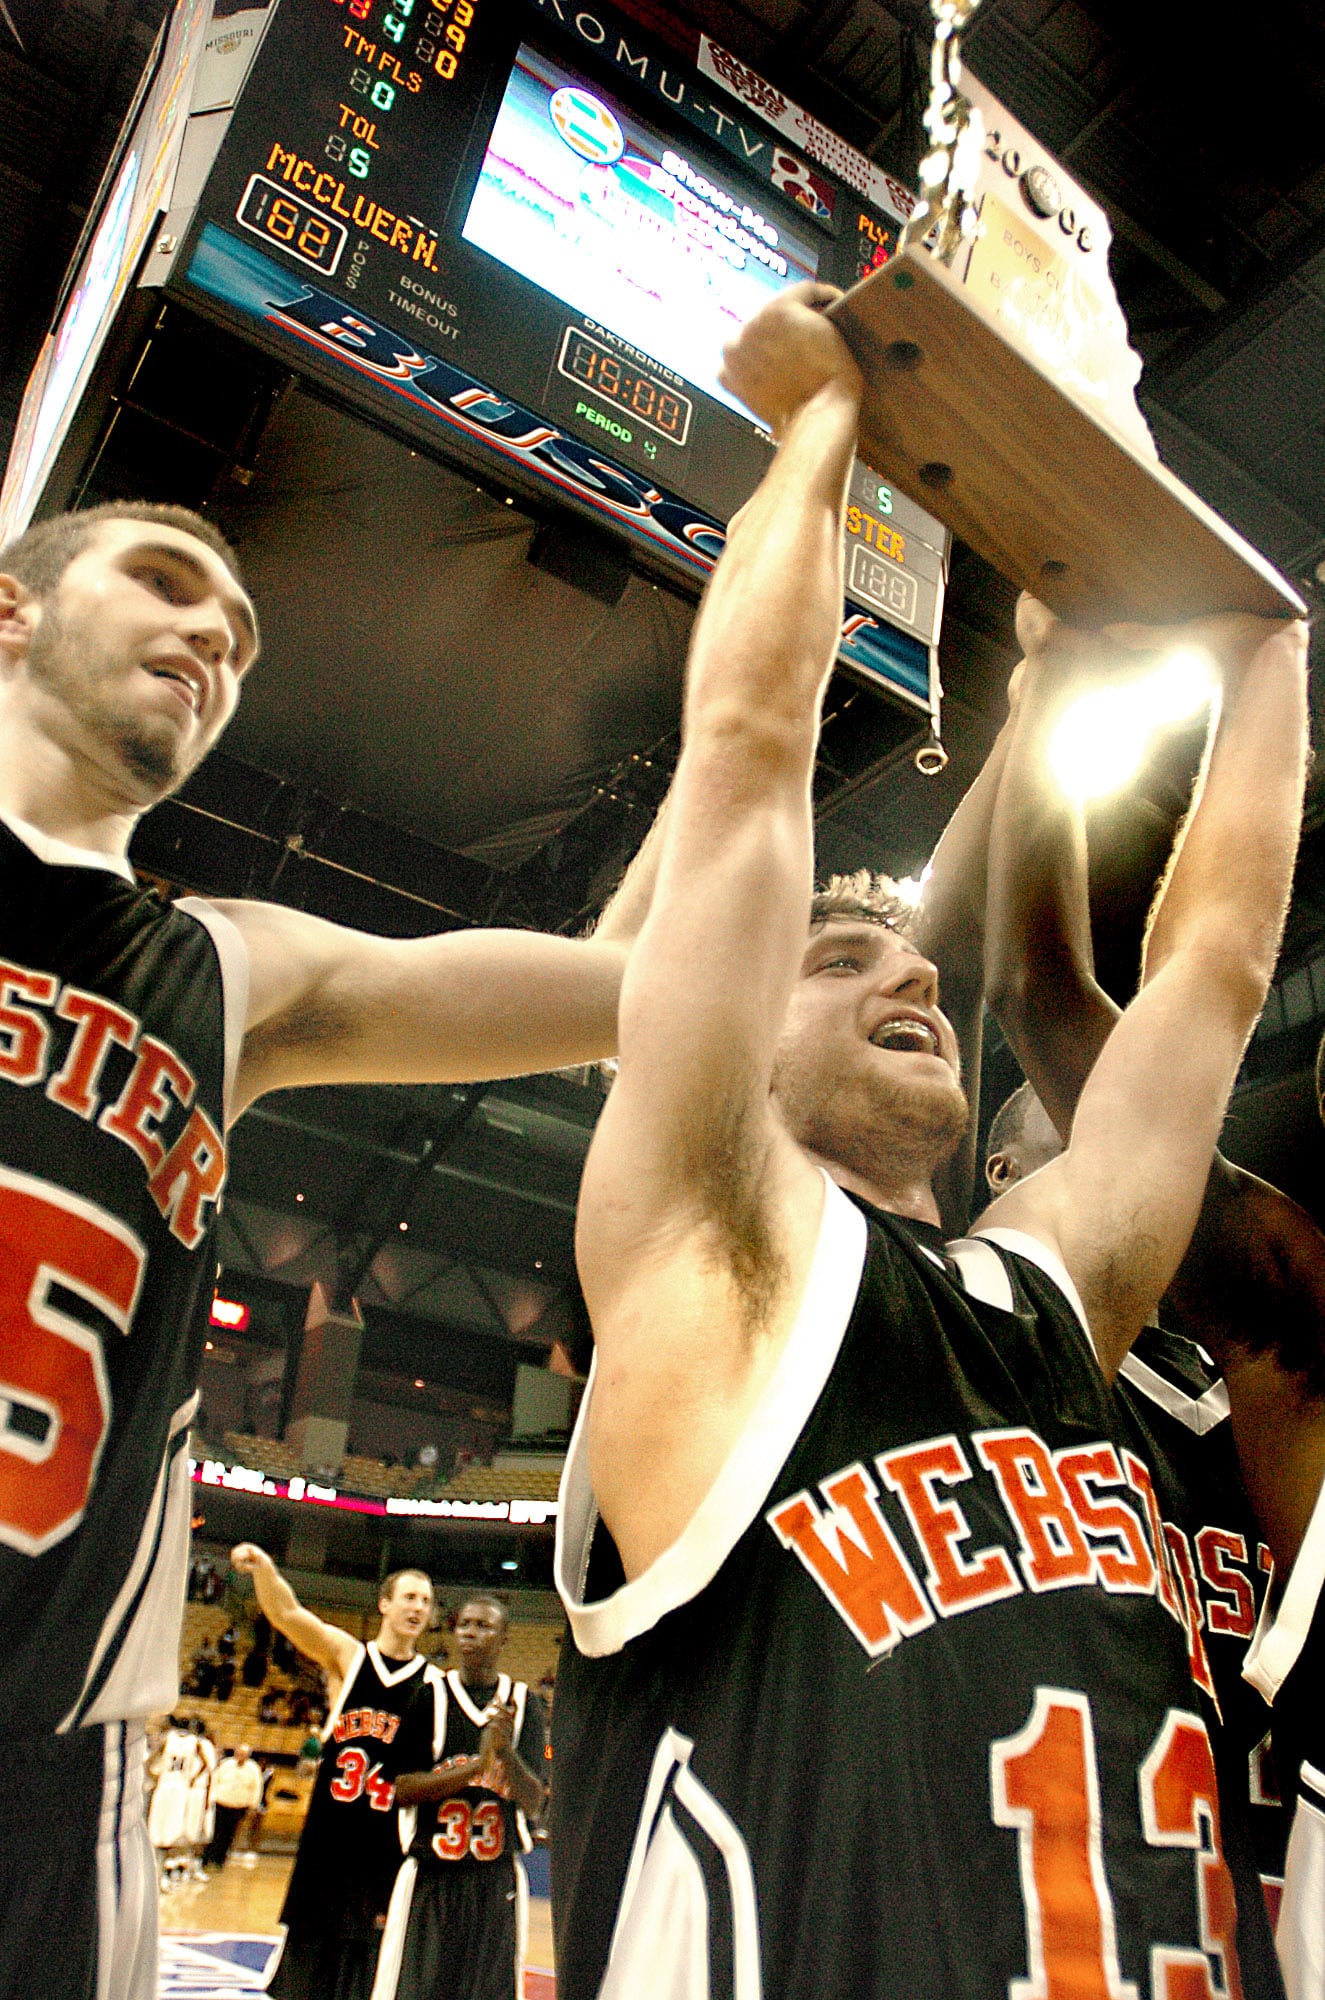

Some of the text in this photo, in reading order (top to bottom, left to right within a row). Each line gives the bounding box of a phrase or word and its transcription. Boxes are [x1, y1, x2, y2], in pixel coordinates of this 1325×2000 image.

[388, 289, 460, 340] TIMEOUT
[400, 275, 459, 318] BONUS
[584, 317, 685, 387] DAKTRONICS
[575, 402, 634, 443] PERIOD
[330, 1746, 397, 1812] 34
[431, 1800, 505, 1861] 33
